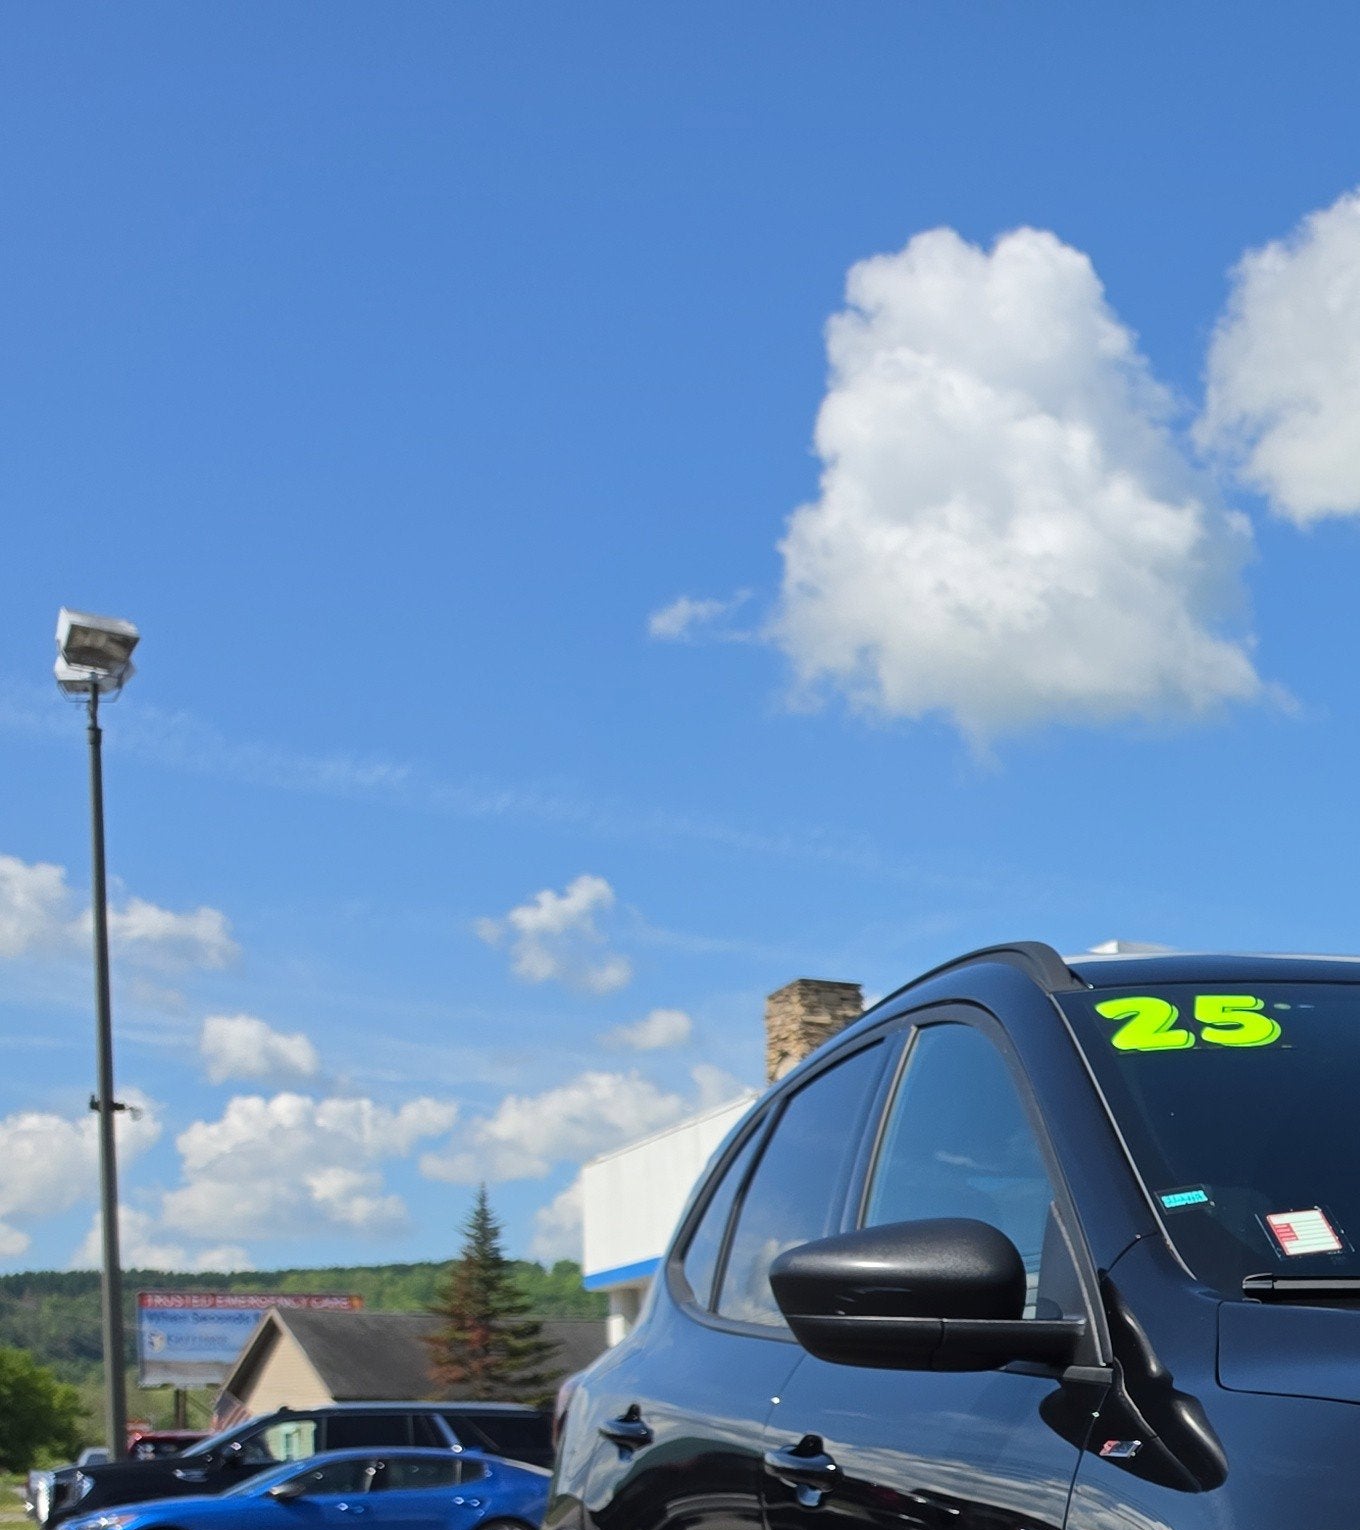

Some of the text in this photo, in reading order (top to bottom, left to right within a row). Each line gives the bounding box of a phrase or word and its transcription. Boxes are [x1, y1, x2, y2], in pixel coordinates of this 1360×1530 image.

[1094, 994, 1282, 1052] 25
[146, 1294, 213, 1308] TRUSTED
[215, 1294, 308, 1309] EMERGENCY
